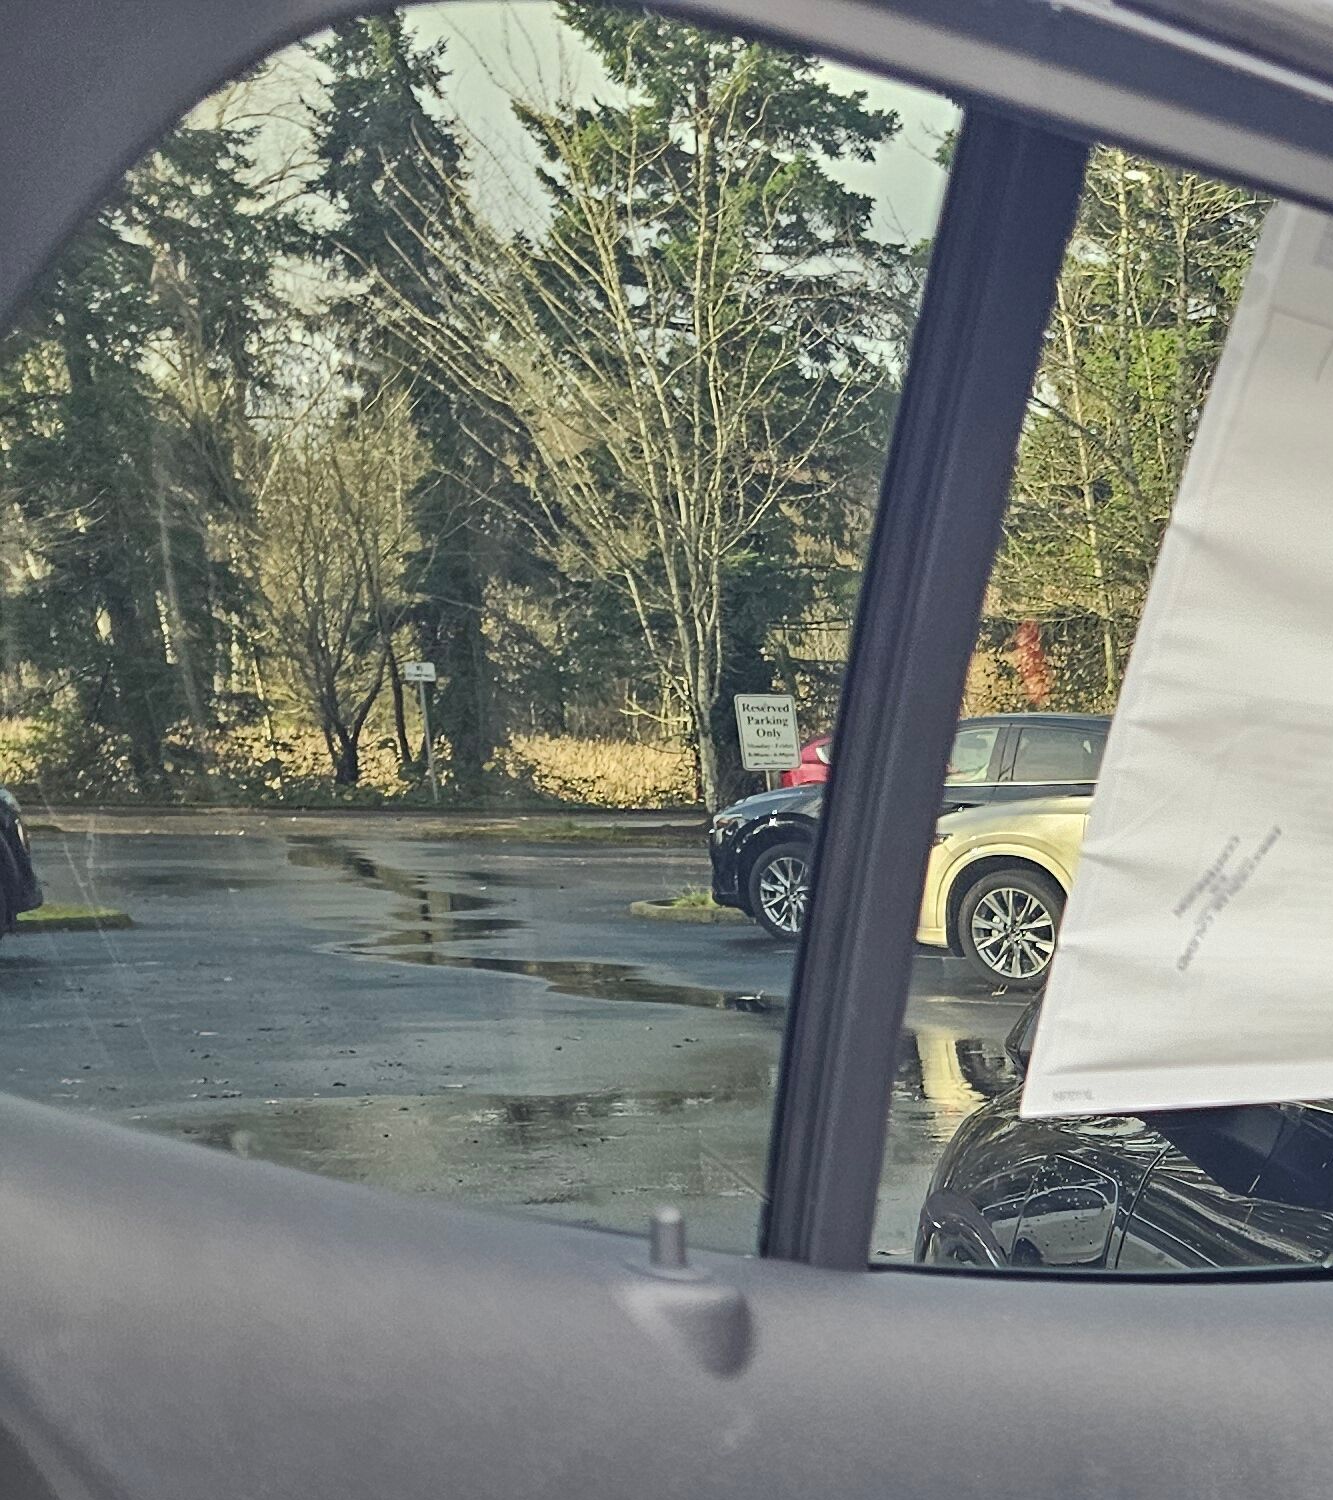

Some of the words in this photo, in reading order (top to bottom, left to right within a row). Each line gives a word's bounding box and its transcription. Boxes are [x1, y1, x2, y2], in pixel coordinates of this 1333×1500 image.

[742, 703, 790, 713] Reserved
[747, 715, 789, 727] Parking
[756, 728, 782, 739] Only
